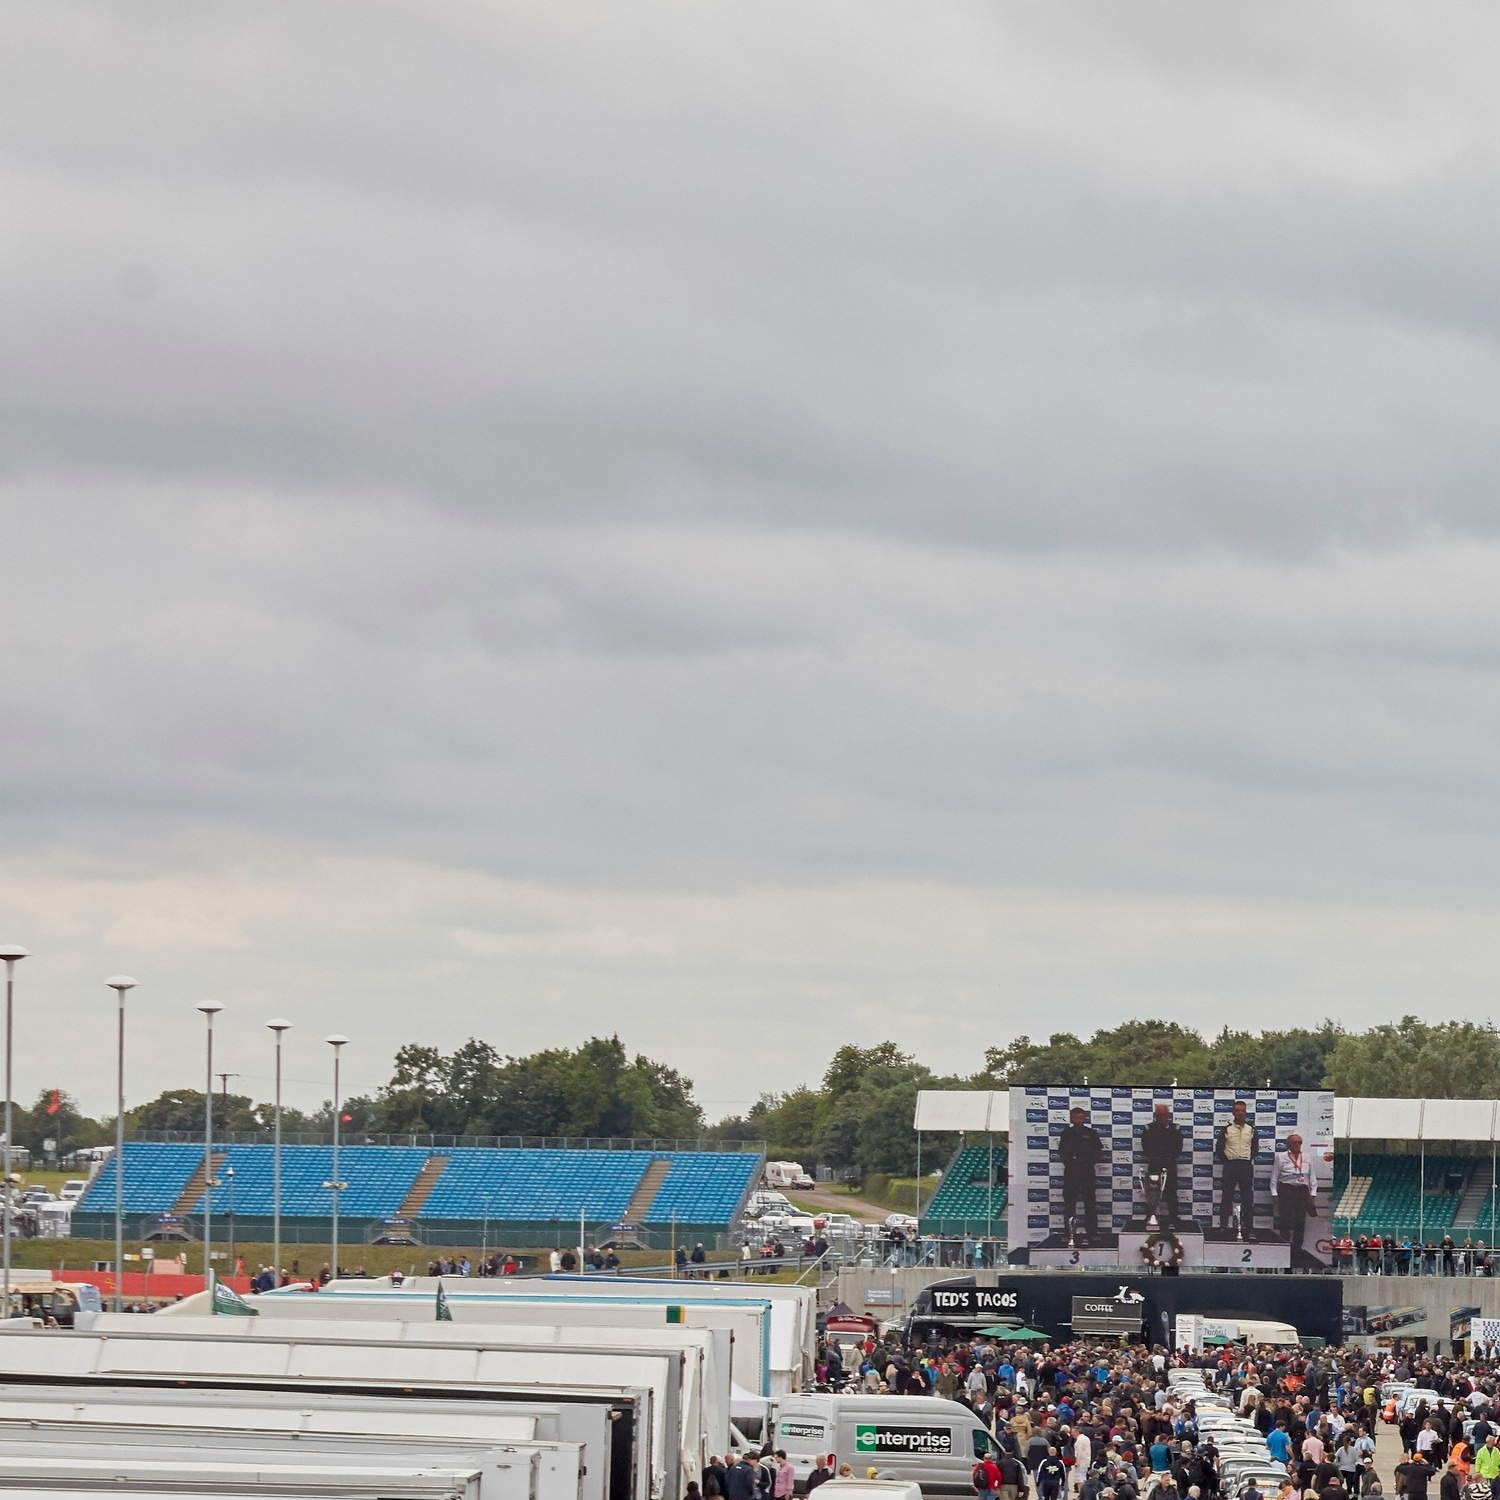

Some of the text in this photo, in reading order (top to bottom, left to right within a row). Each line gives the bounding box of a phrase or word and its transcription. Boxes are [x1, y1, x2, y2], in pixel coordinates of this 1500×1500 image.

[1158, 1243, 1165, 1256] 1
[1241, 1249, 1252, 1263] 2
[1070, 1251, 1080, 1264] 3
[934, 1292, 1018, 1308] TED'S TACOS
[1085, 1303, 1114, 1313] COFFEE
[783, 1425, 824, 1437] enterprise
[859, 1431, 951, 1450] enterprise
